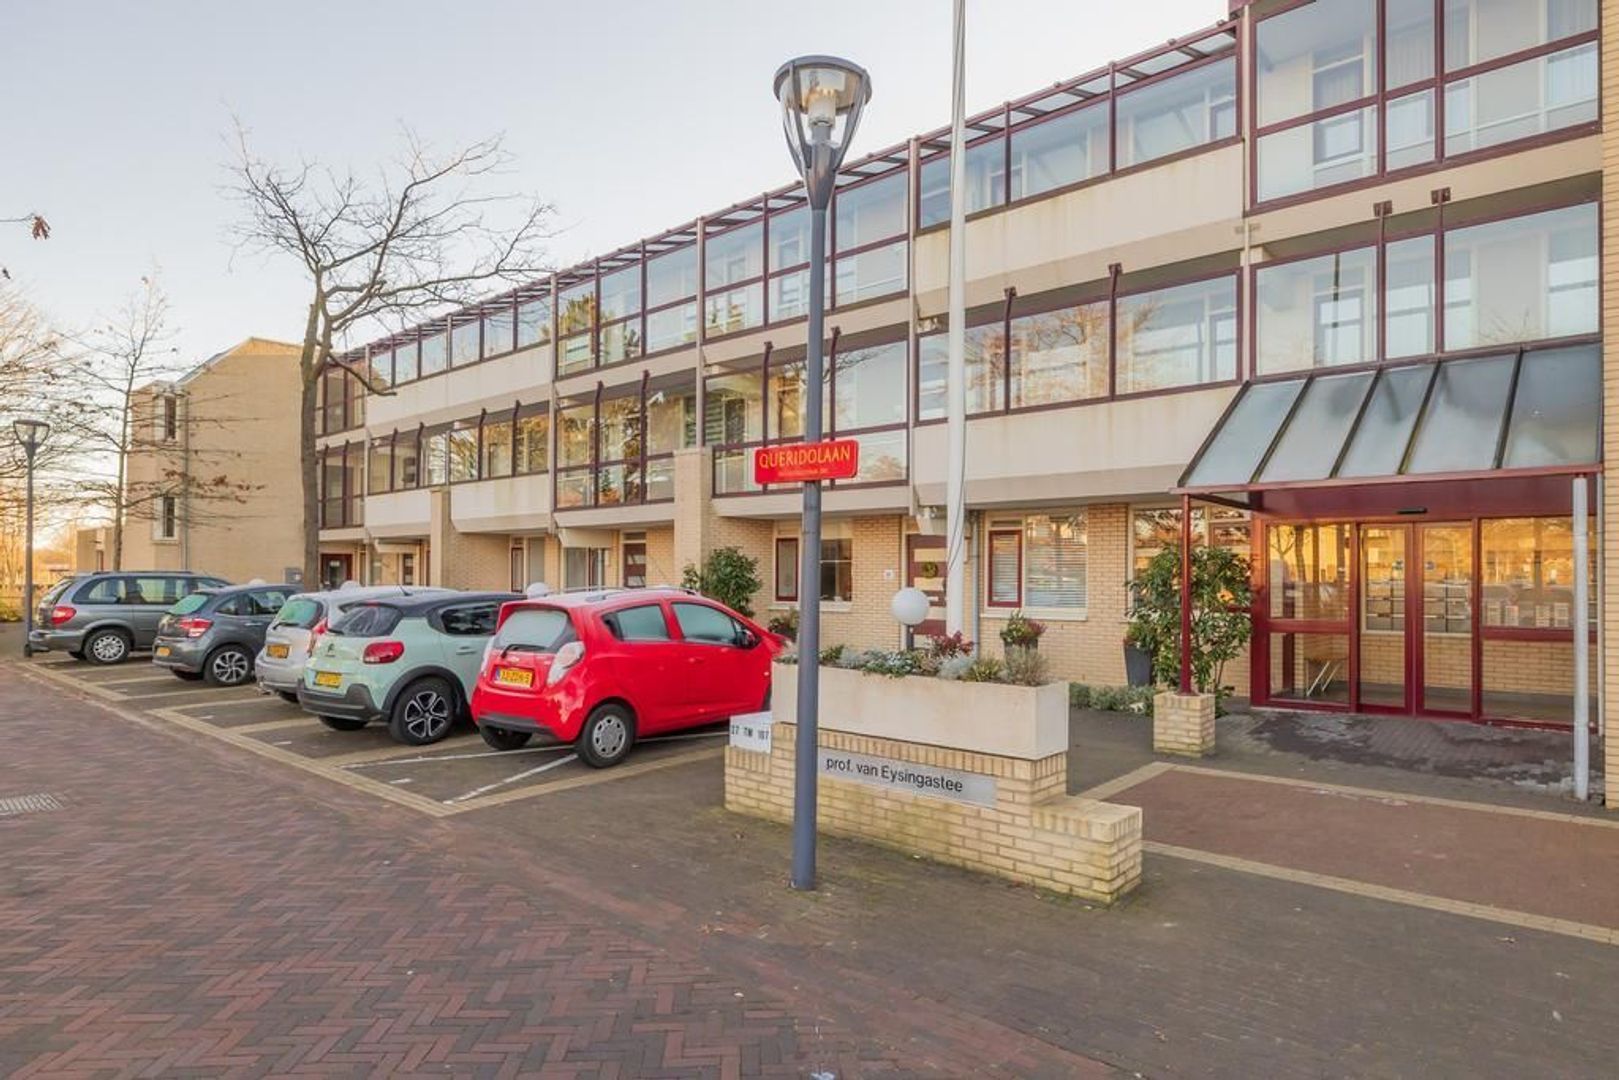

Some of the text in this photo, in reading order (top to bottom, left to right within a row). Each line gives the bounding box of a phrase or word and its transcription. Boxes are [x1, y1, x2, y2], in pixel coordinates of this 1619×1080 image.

[759, 445, 850, 468] QUERIDOLAAN
[826, 757, 963, 793] prof. van Eysingastee
